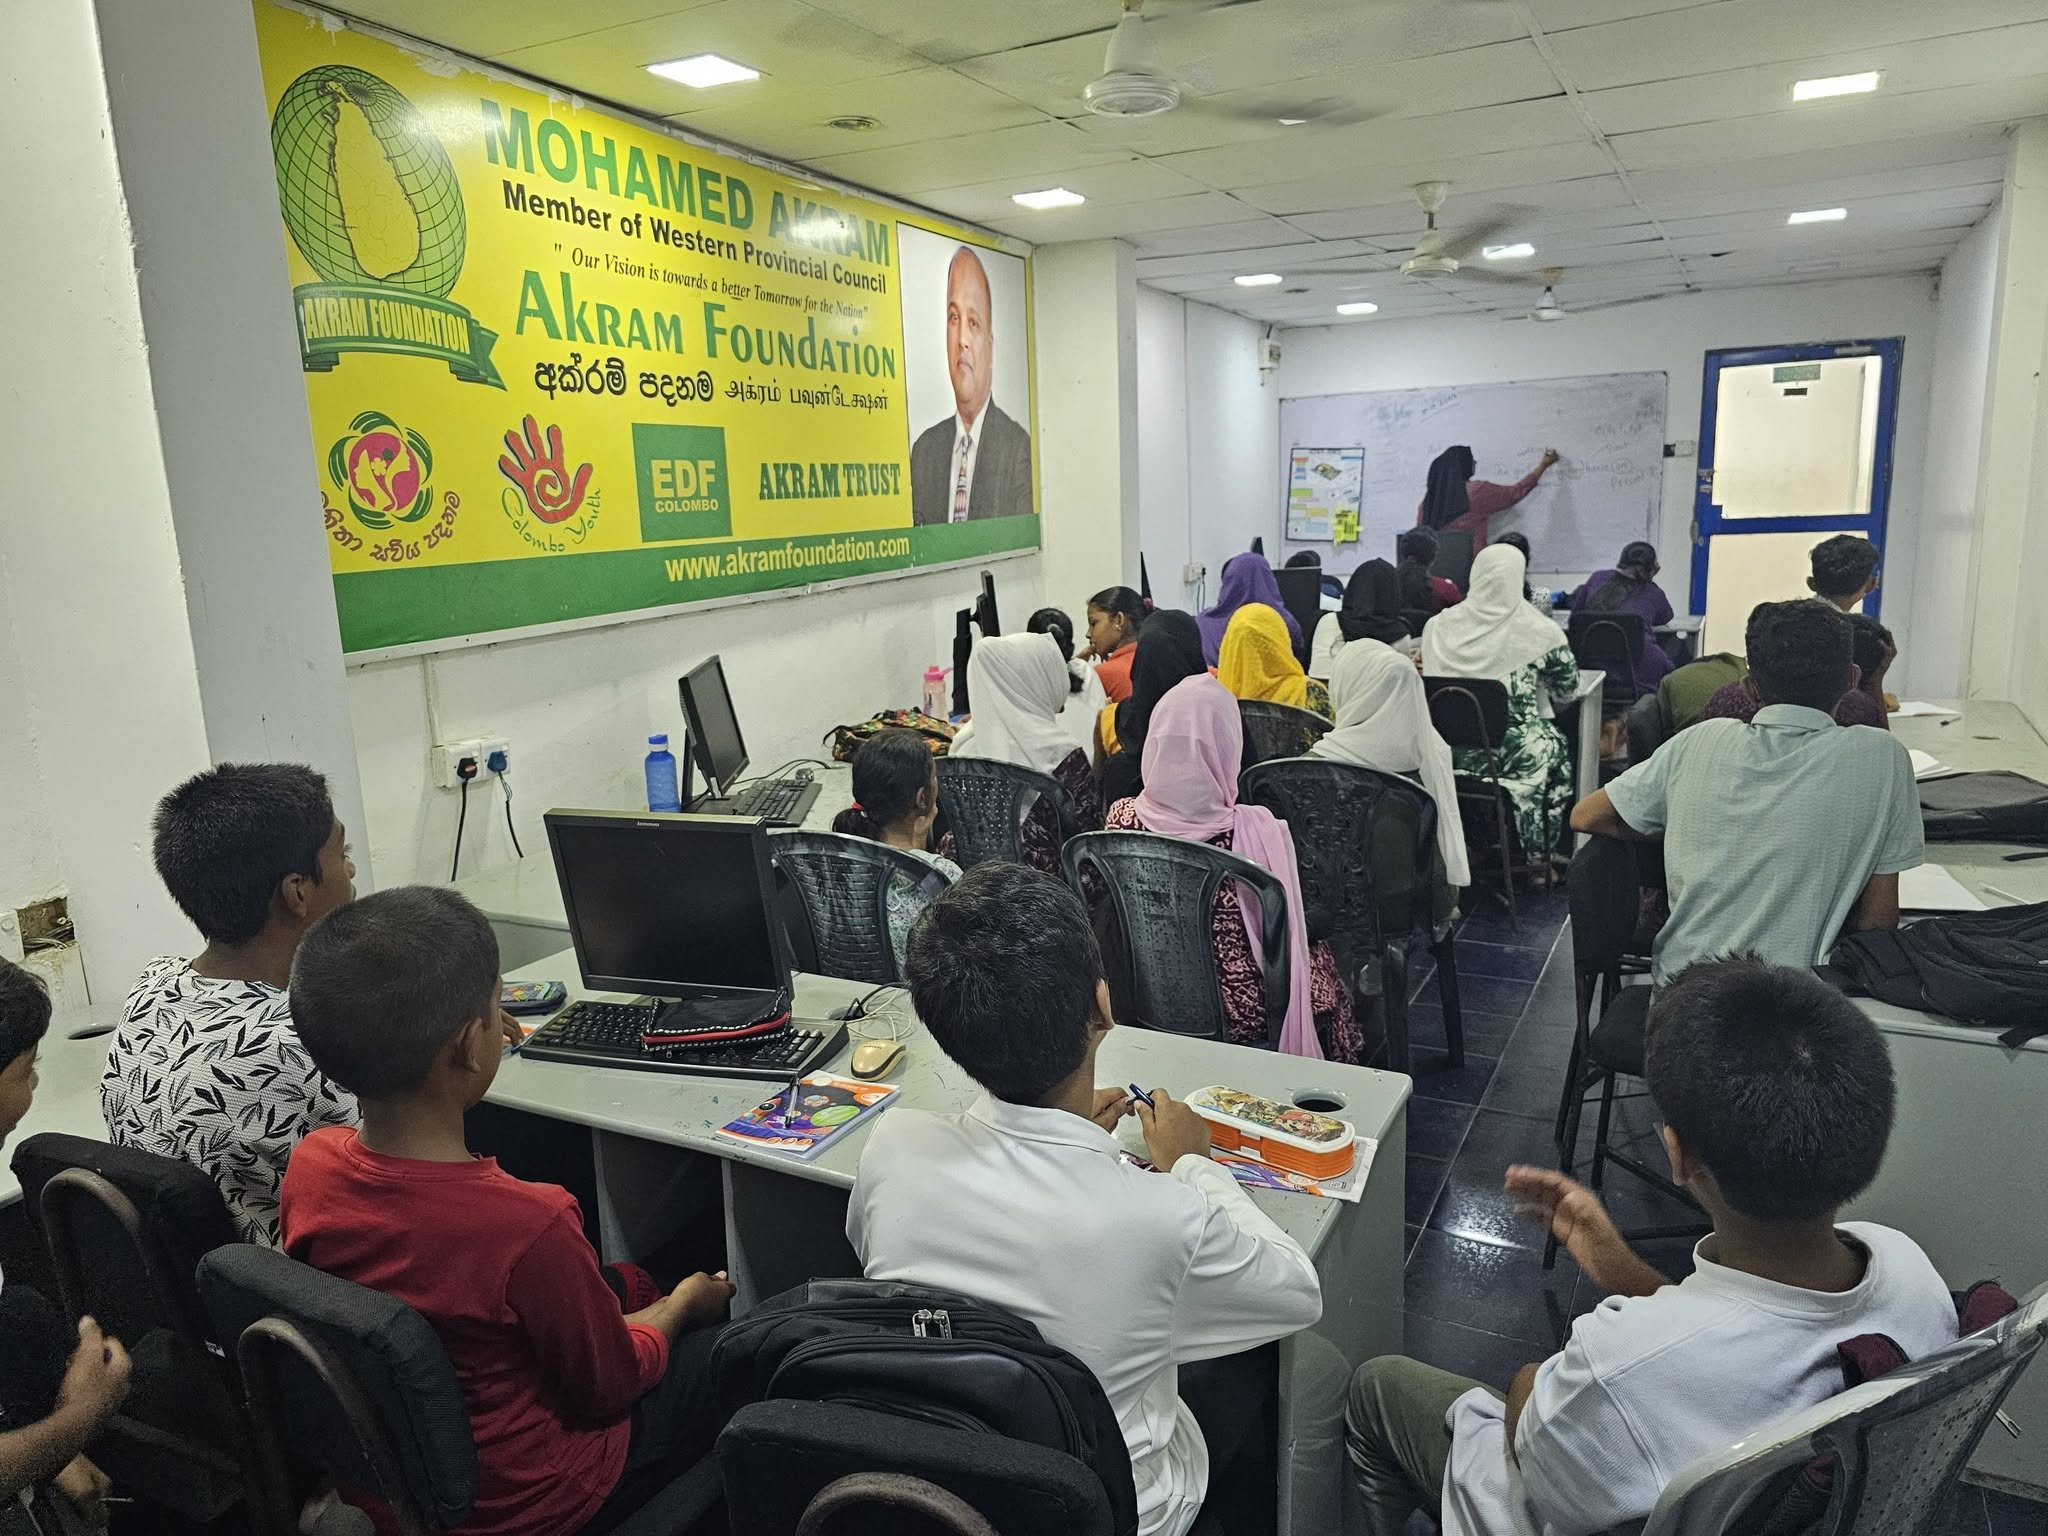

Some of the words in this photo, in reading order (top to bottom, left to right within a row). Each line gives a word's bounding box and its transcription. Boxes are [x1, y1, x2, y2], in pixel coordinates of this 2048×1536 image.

[481, 98, 754, 231] MOHAMED
[768, 191, 890, 267] AKRAM
[502, 179, 612, 231] Member
[620, 213, 642, 239] of
[650, 216, 737, 261] Western
[743, 240, 828, 281] Provincial
[833, 263, 887, 294] Council
[605, 253, 645, 278] Vision
[649, 263, 659, 282] is
[663, 268, 708, 291] towards
[711, 281, 718, 292] a
[721, 278, 751, 299] better
[754, 284, 802, 307] Tomorrow
[803, 295, 817, 313] for
[819, 299, 833, 314] the
[303, 298, 369, 340] AKRAM
[368, 299, 471, 355] FOUNDATION
[639, 370, 714, 407] පදනම
[725, 375, 782, 405] அக்ரம்
[650, 459, 716, 499] EDF
[759, 462, 841, 500] AKRAM
[843, 462, 901, 496] TRUST
[501, 487, 566, 552] Colombo
[564, 487, 601, 545] Youth
[654, 498, 719, 514] COLOMBO
[665, 537, 910, 582] www.akramfoundation.com
